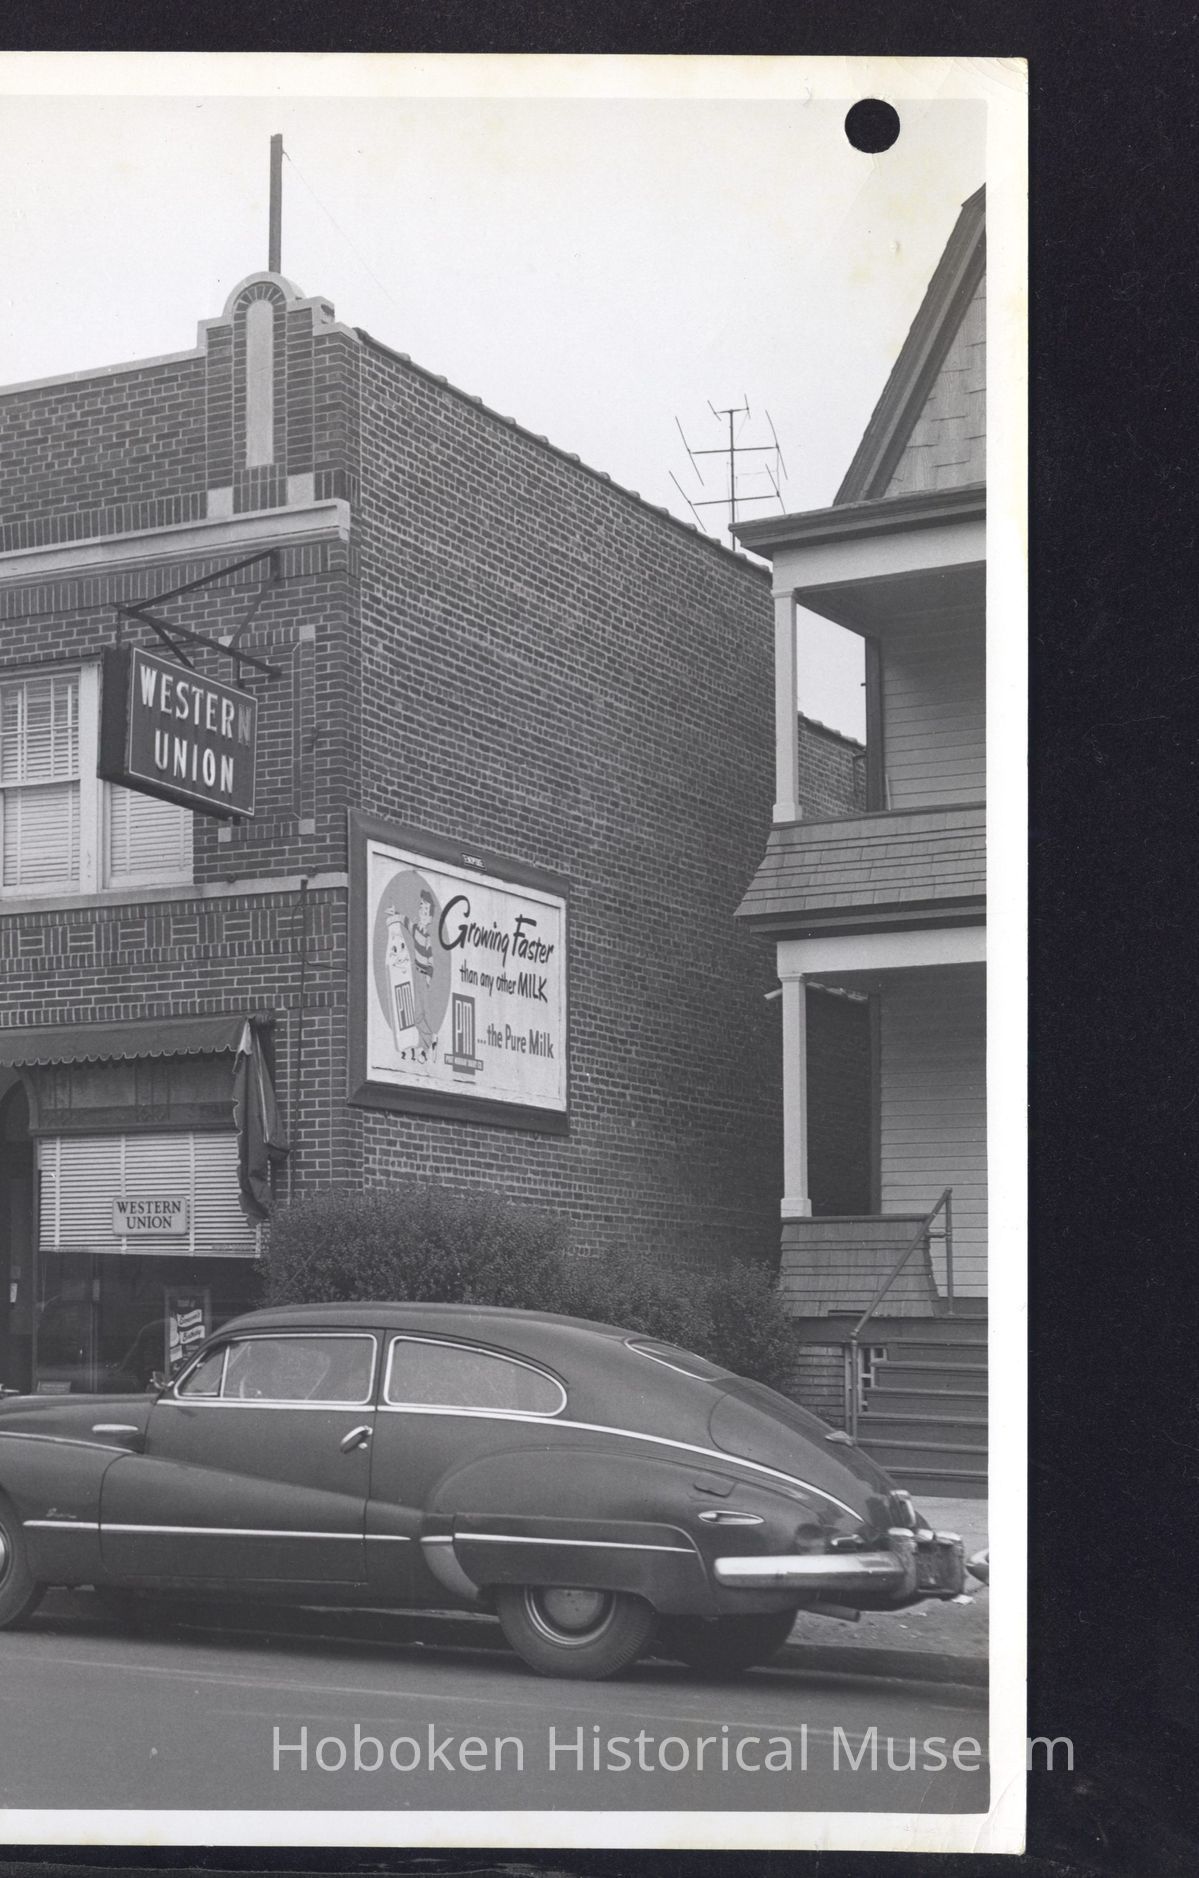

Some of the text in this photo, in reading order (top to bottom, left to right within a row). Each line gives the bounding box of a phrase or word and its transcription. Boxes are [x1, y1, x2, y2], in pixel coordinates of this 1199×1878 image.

[140, 663, 252, 746] WESTERN
[155, 727, 234, 794] UNION
[439, 895, 555, 968] Growing Faster
[459, 959, 548, 1003] than any other MILK
[505, 1024, 527, 1053] Pure
[529, 1029, 554, 1059] Milk
[116, 1200, 181, 1214] WESTERN
[126, 1215, 172, 1229] UNION
